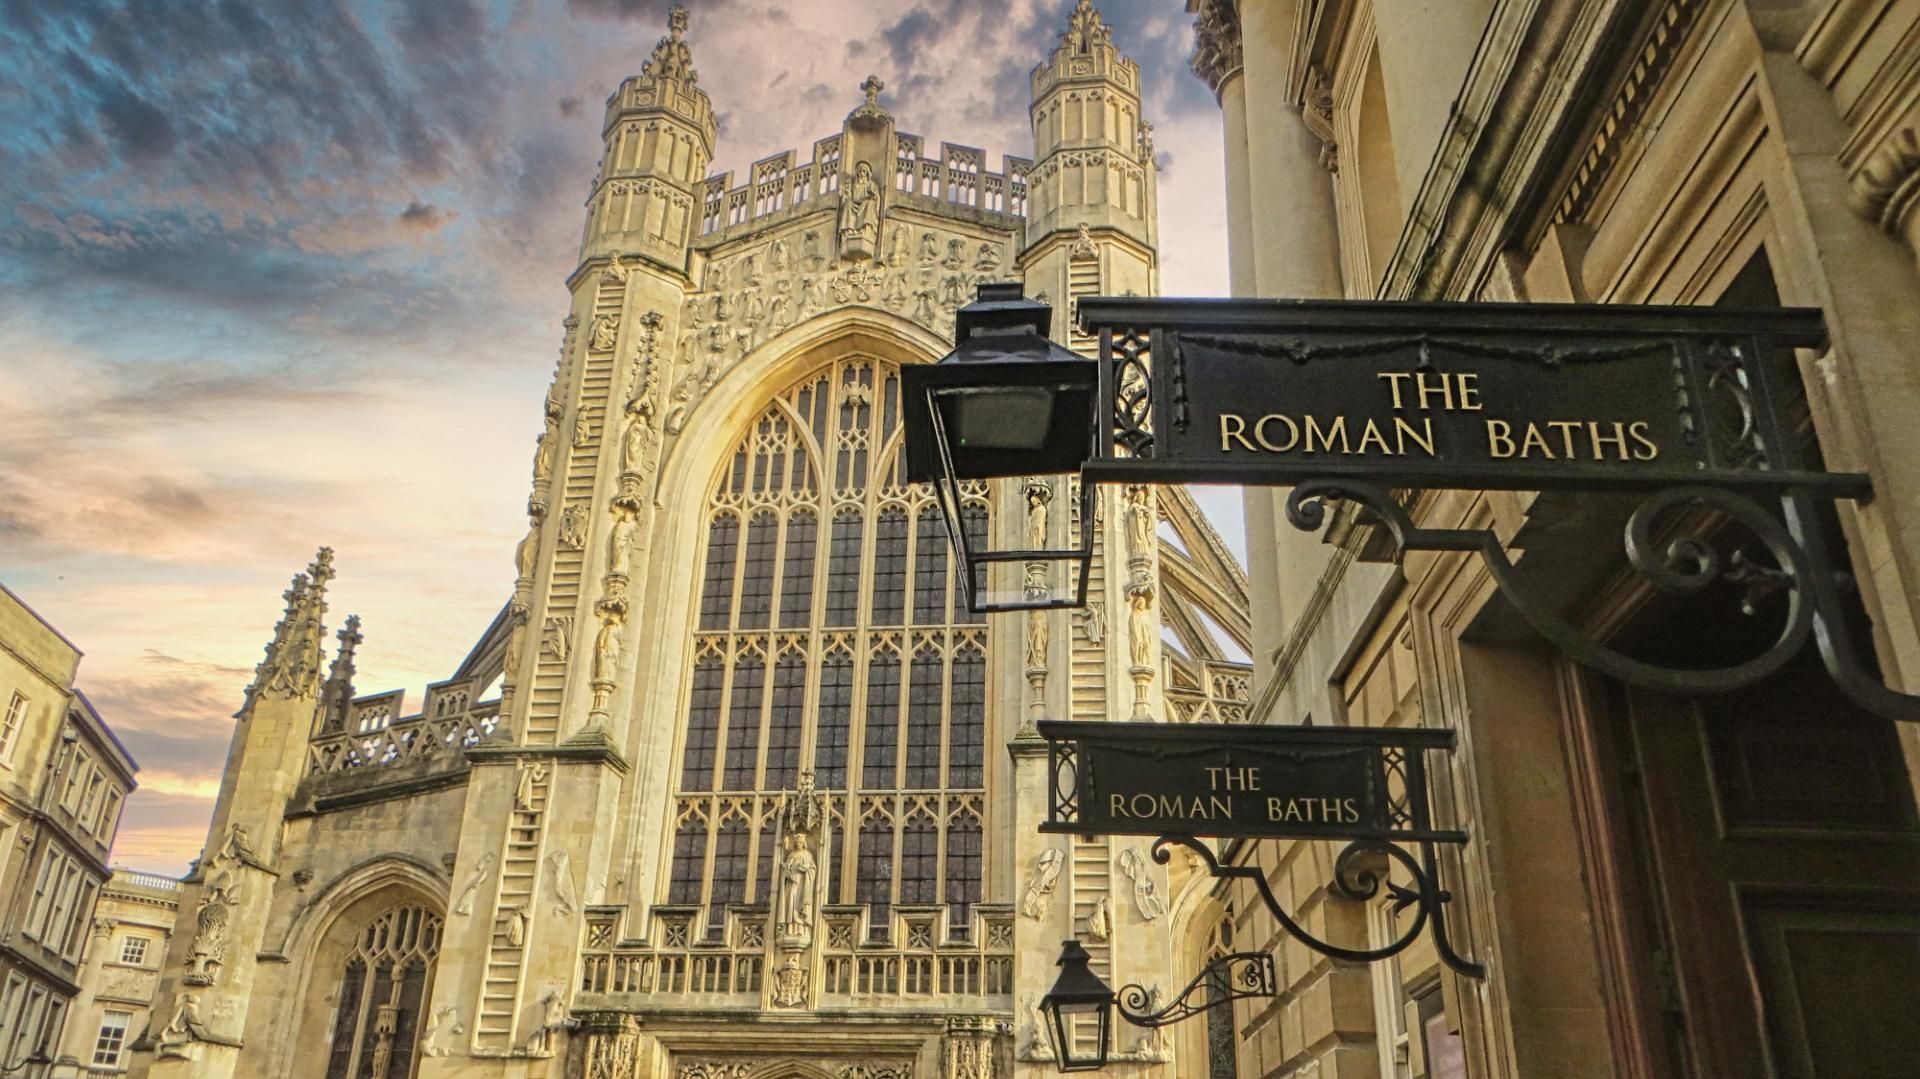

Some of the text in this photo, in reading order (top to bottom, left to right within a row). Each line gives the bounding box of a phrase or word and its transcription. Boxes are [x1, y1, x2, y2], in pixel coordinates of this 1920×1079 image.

[1378, 372, 1483, 411] THE
[1219, 413, 1658, 461] ROMAN BATHS
[1205, 767, 1260, 791] THE
[1110, 794, 1360, 823] ROMAN BATHS
